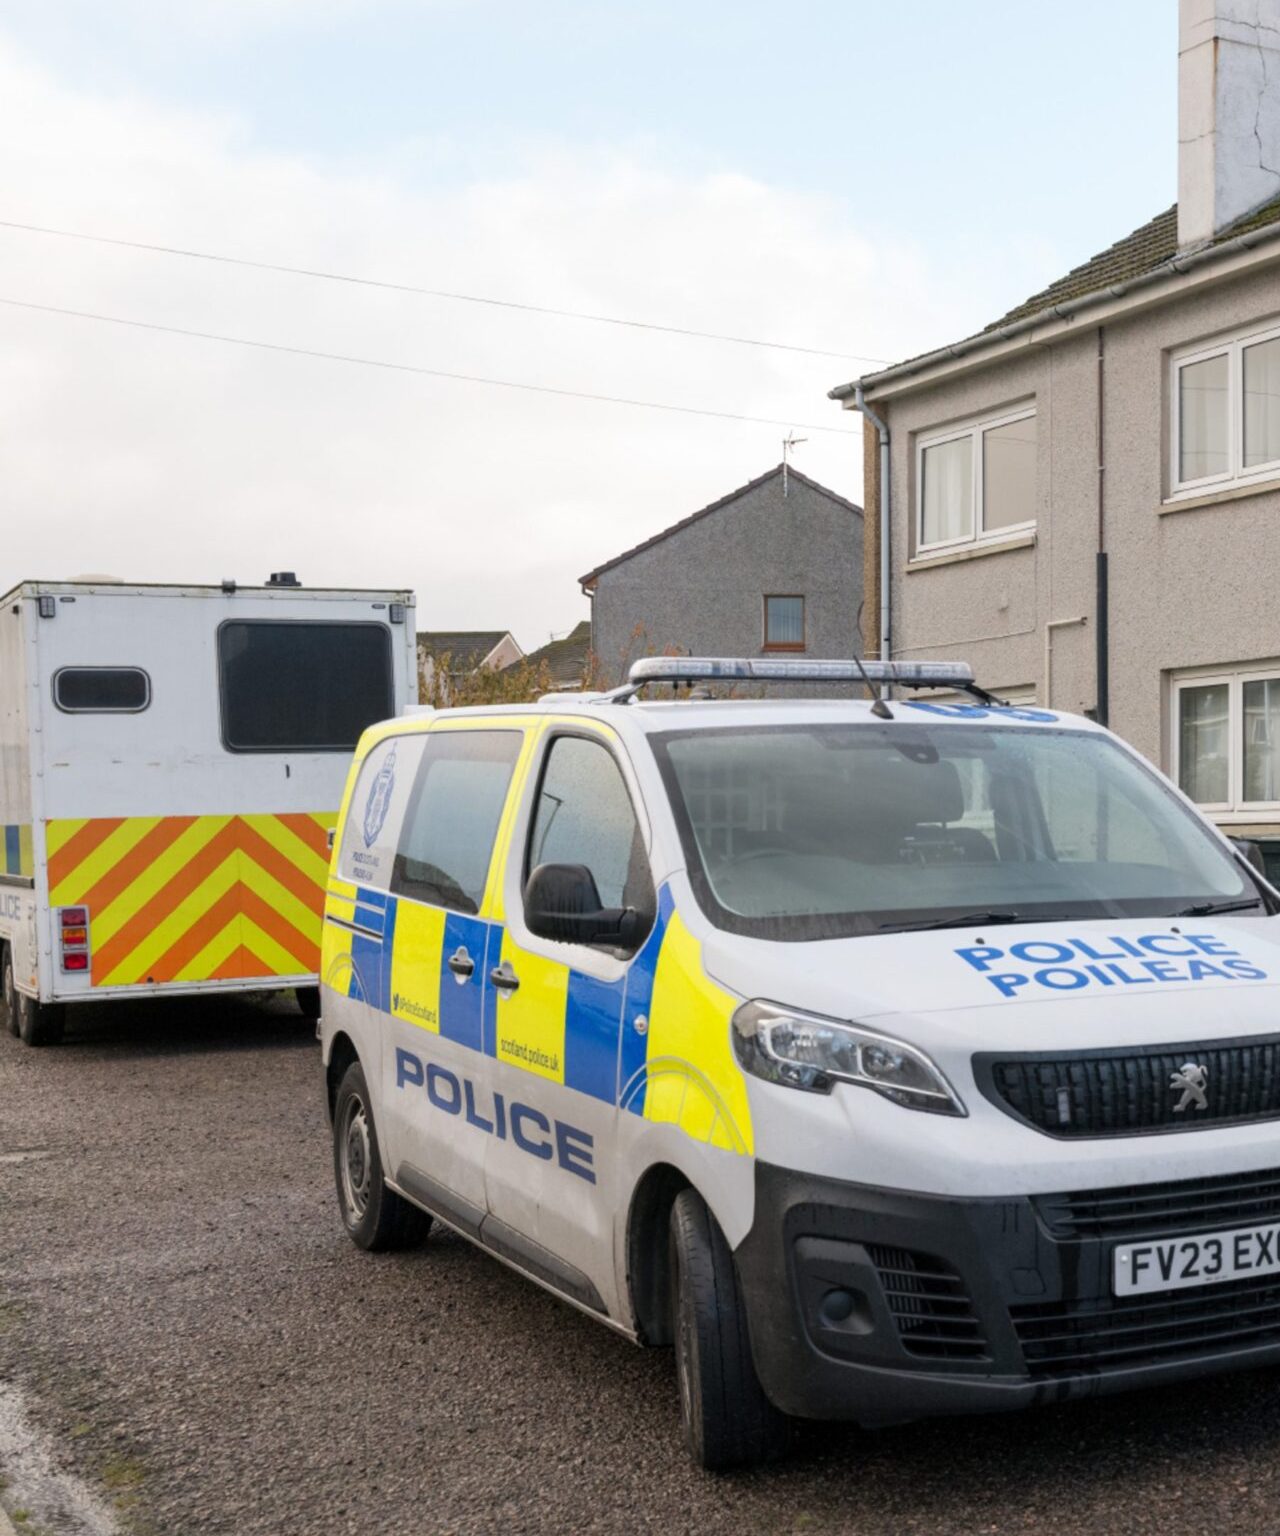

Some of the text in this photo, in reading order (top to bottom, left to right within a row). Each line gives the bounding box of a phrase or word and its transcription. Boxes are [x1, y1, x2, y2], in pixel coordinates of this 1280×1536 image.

[953, 934, 1241, 971] POLICE
[986, 959, 1268, 998] POILEAS
[500, 1038, 560, 1072] scotland.police.uk
[395, 1047, 597, 1185] POLICE
[1131, 1239, 1223, 1285] FV23
